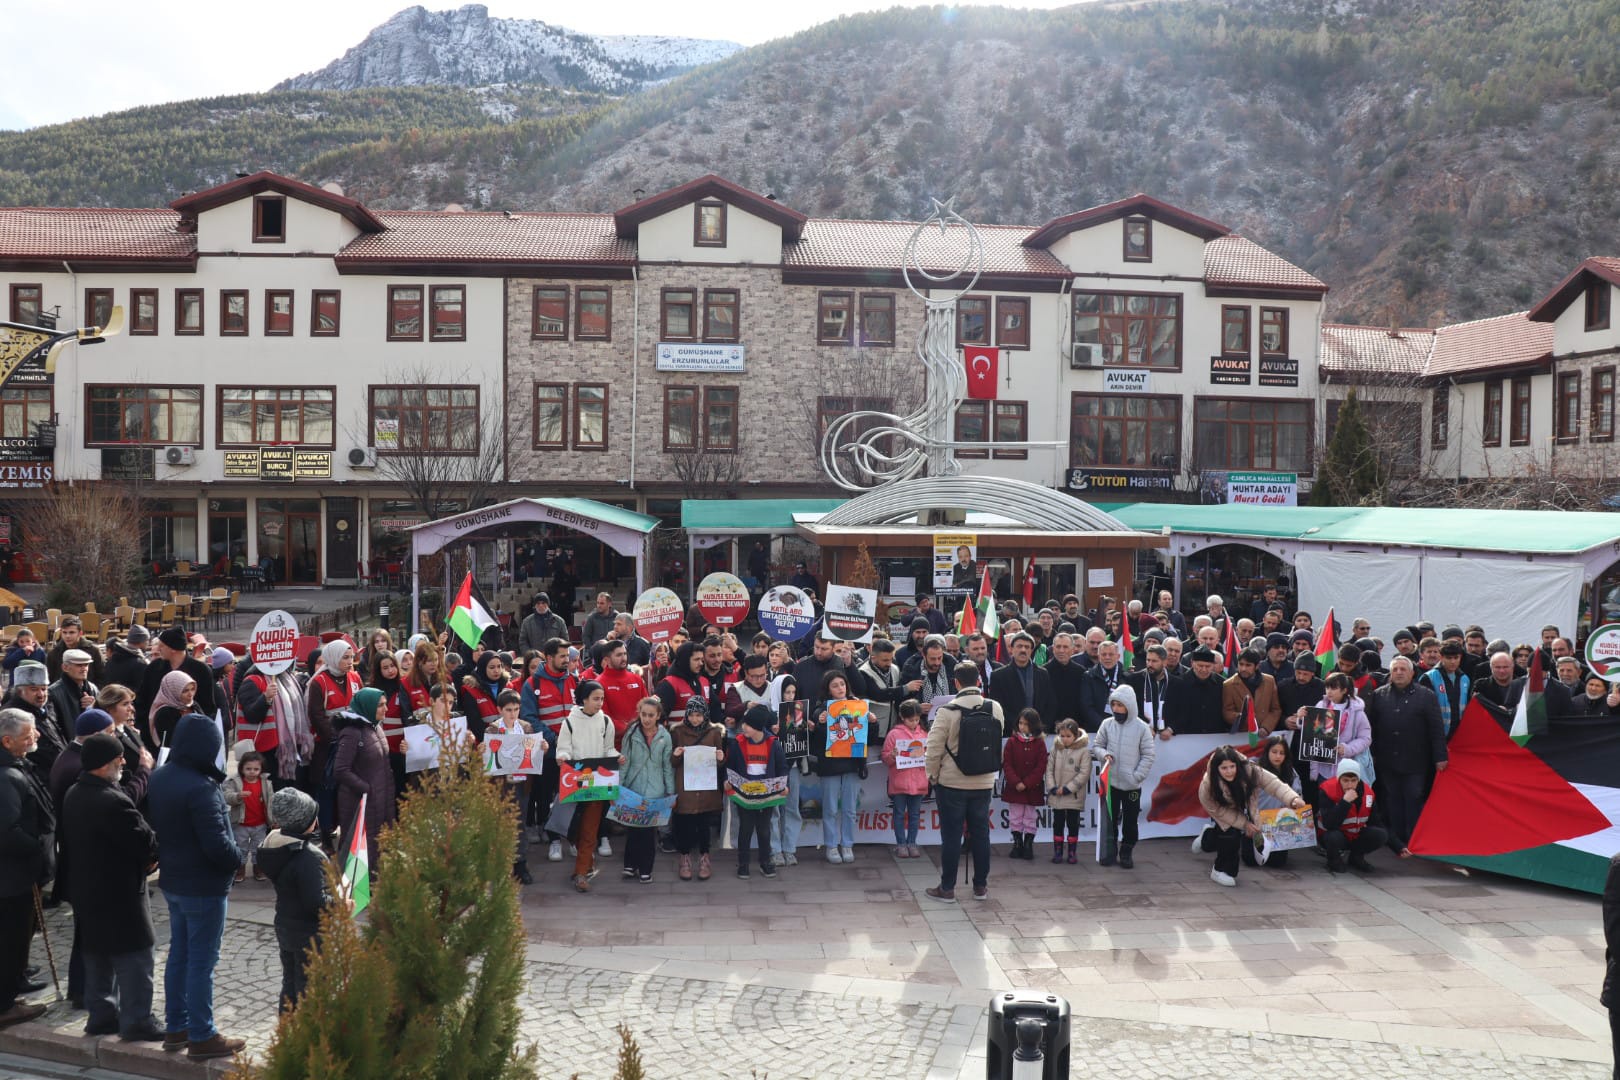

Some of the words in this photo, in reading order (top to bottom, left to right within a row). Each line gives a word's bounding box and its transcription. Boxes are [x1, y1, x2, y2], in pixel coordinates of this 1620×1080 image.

[671, 357, 730, 365] ERZURUMLULAR
[1213, 359, 1250, 370] AVUKAT
[1261, 361, 1297, 372] AVUKAT
[1107, 373, 1147, 383] AVUKAT
[262, 451, 292, 459] AVUKAT
[1232, 485, 1266, 493] MUHTAR
[1233, 494, 1260, 503] Murat
[1261, 494, 1286, 504] Gedik
[455, 507, 513, 530] GÜMÜŞHANE
[546, 509, 599, 531] BELEDİYESİ
[661, 612, 680, 622] DEVAM
[256, 627, 296, 643] KUDÜS
[256, 640, 293, 653] ÜMMETİN
[256, 650, 293, 662] KALBİDİR
